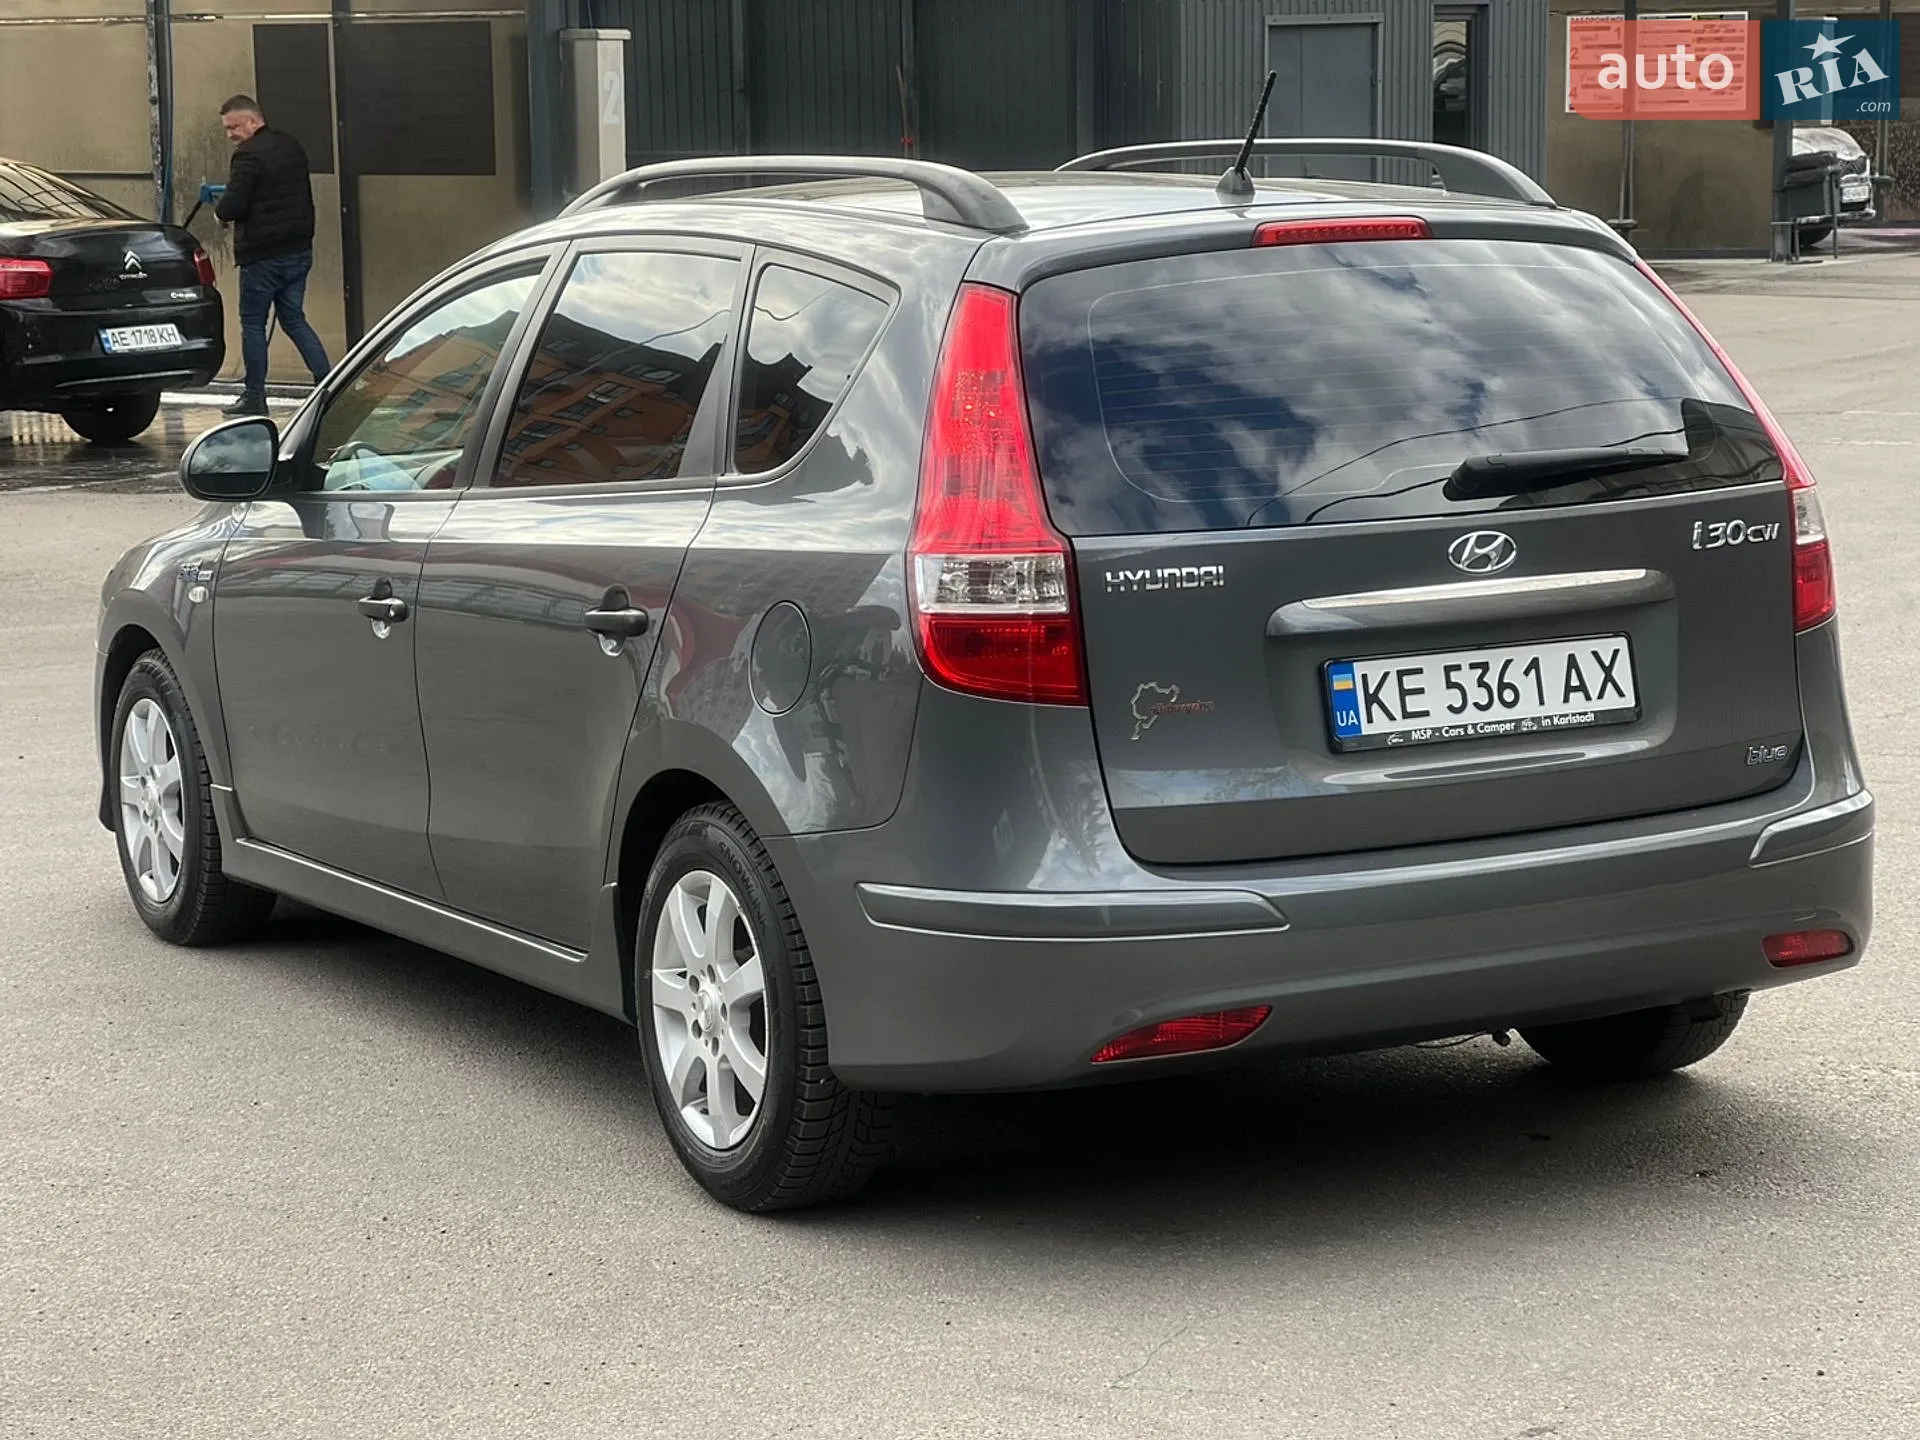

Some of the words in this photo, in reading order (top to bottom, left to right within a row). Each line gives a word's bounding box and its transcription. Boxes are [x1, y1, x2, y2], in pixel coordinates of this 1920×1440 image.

[602, 71, 621, 125] 2
[111, 330, 131, 347] AE
[131, 328, 157, 345] 1718
[157, 326, 177, 342] KH
[1105, 565, 1225, 593] HYUNDAI
[1361, 667, 1430, 724] KE
[1443, 656, 1545, 714] 5361
[1562, 648, 1626, 704] AX
[1337, 711, 1358, 727] UA
[1411, 729, 1432, 741] MSP
[1442, 725, 1465, 737] Cars
[1467, 723, 1475, 735] &
[1477, 720, 1515, 734] Camper
[1541, 716, 1551, 727] in
[1553, 712, 1595, 725] Karlstadt
